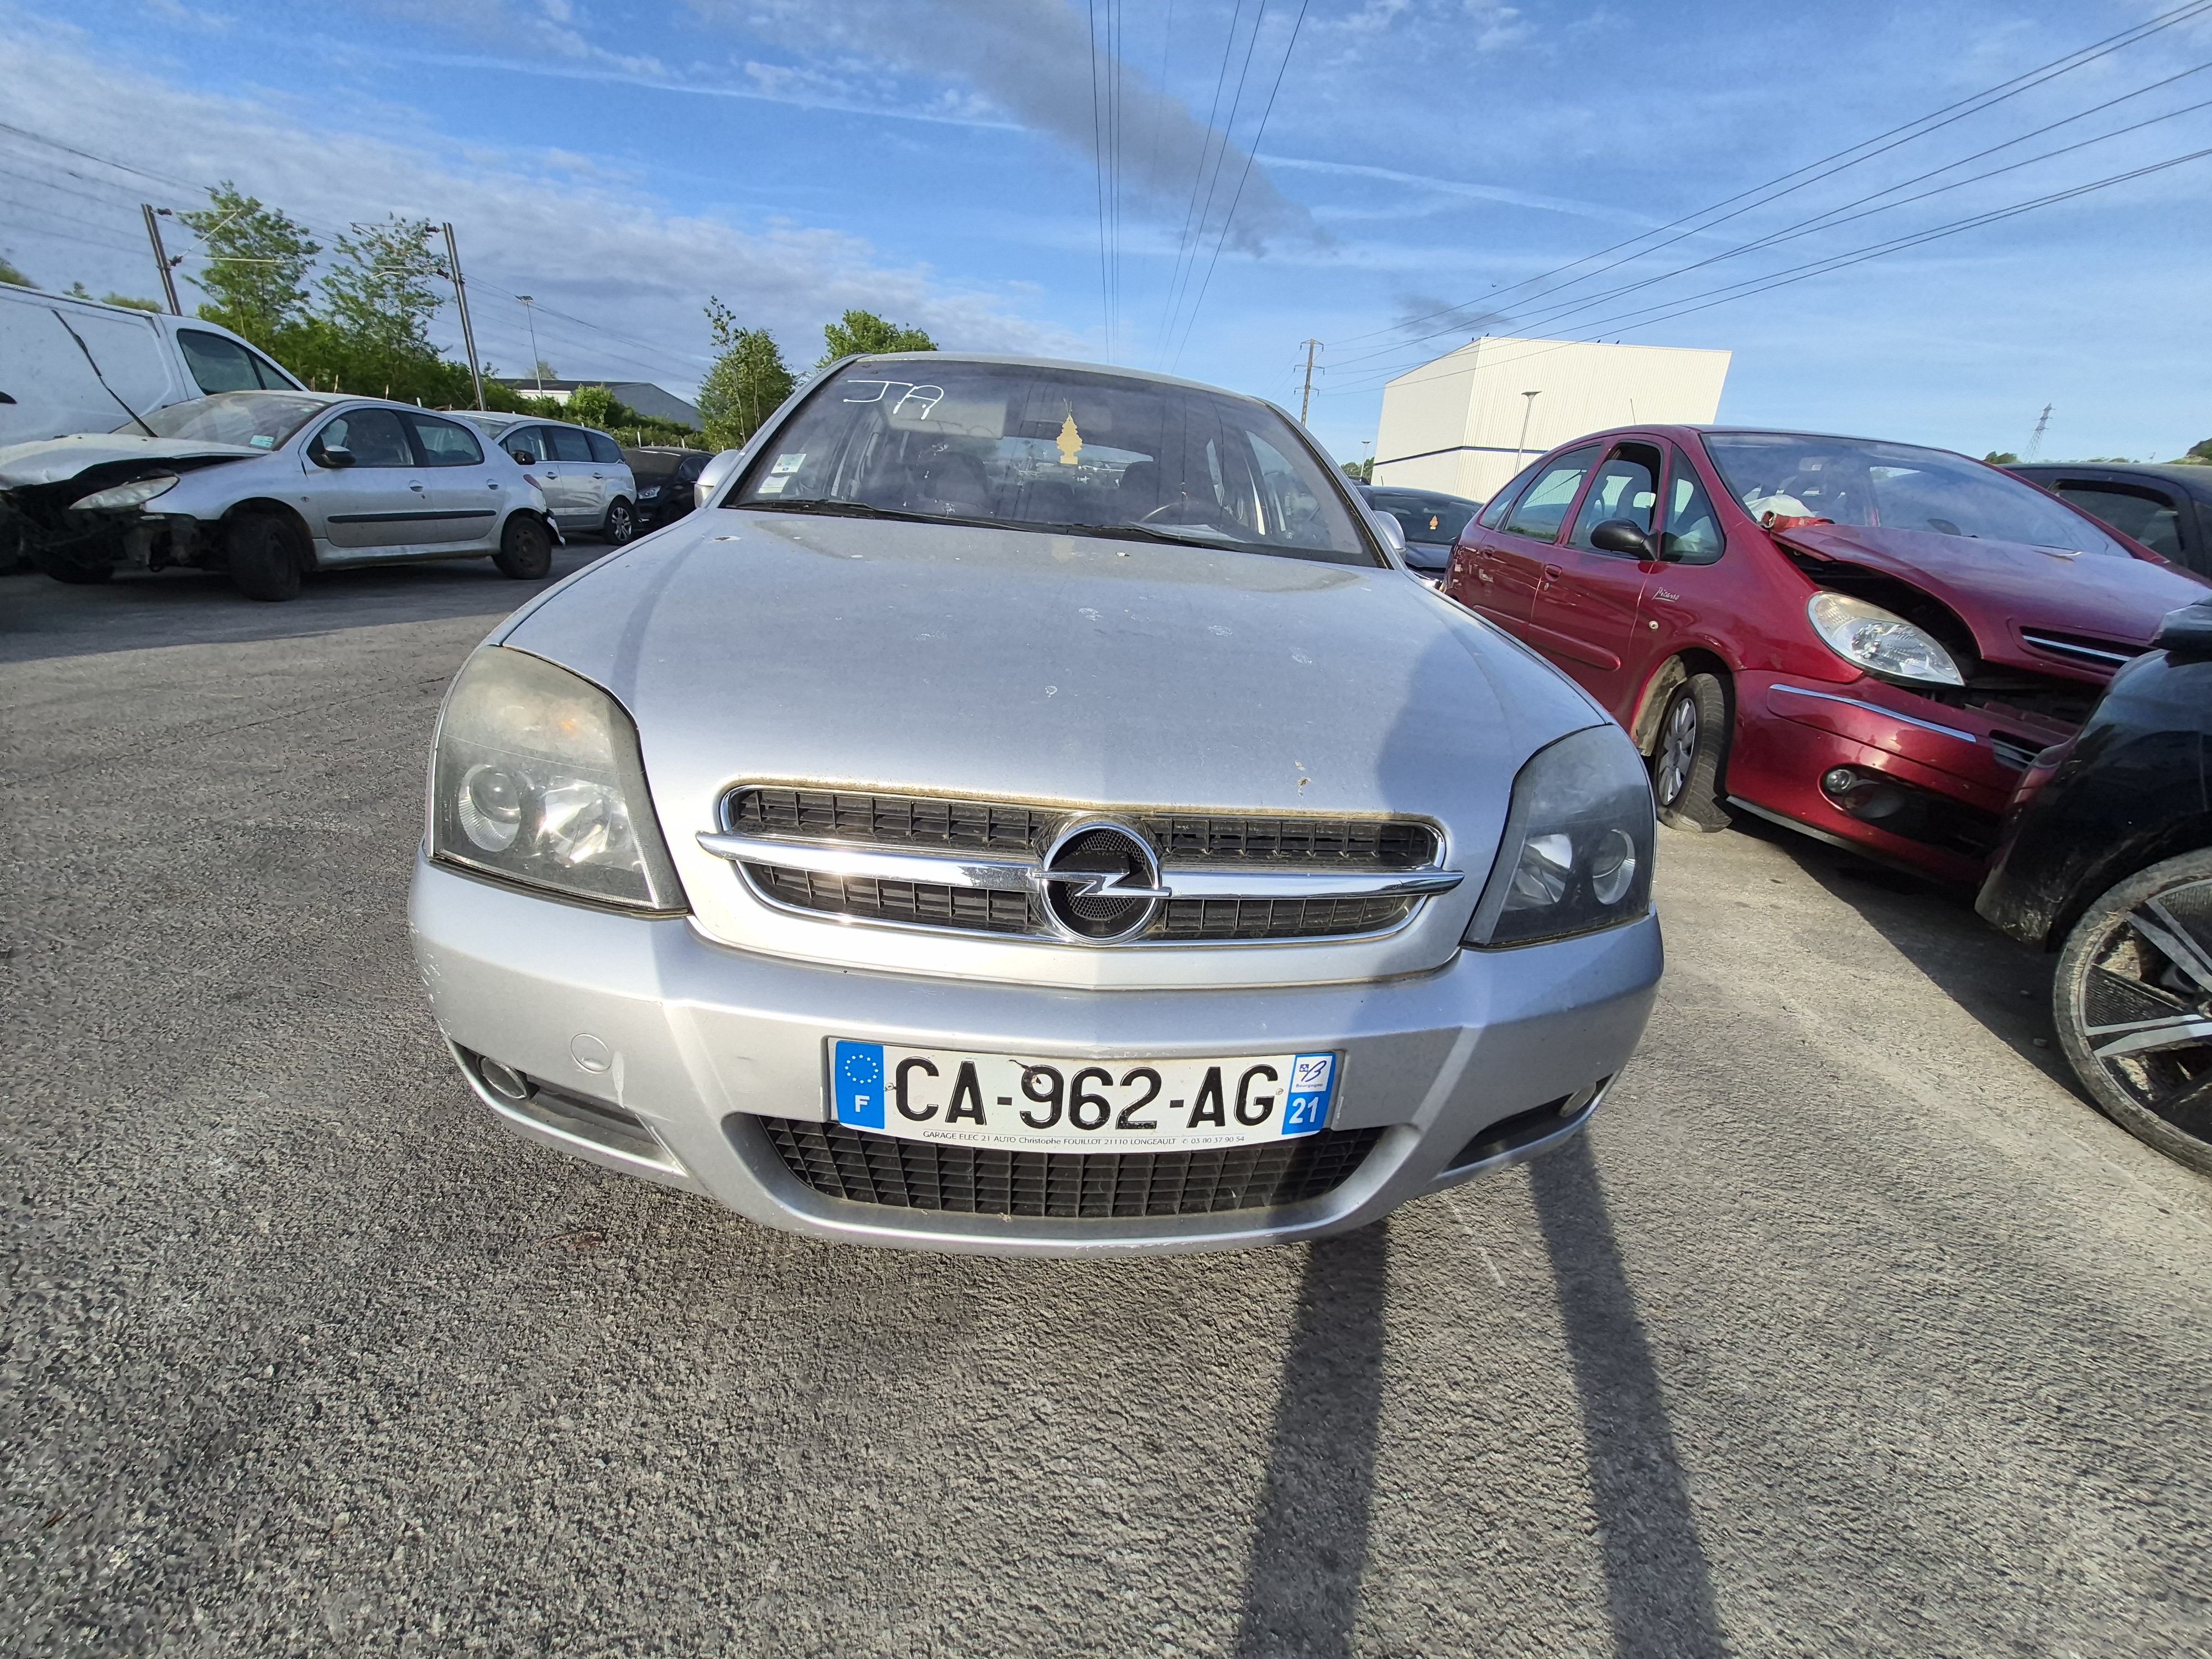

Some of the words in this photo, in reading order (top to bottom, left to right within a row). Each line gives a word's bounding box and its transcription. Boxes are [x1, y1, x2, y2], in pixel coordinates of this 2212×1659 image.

[855, 1095, 870, 1112] F
[895, 1056, 1279, 1131] CA-962-AG
[1288, 1097, 1319, 1124] 21
[923, 1131, 956, 1139] GARAGE
